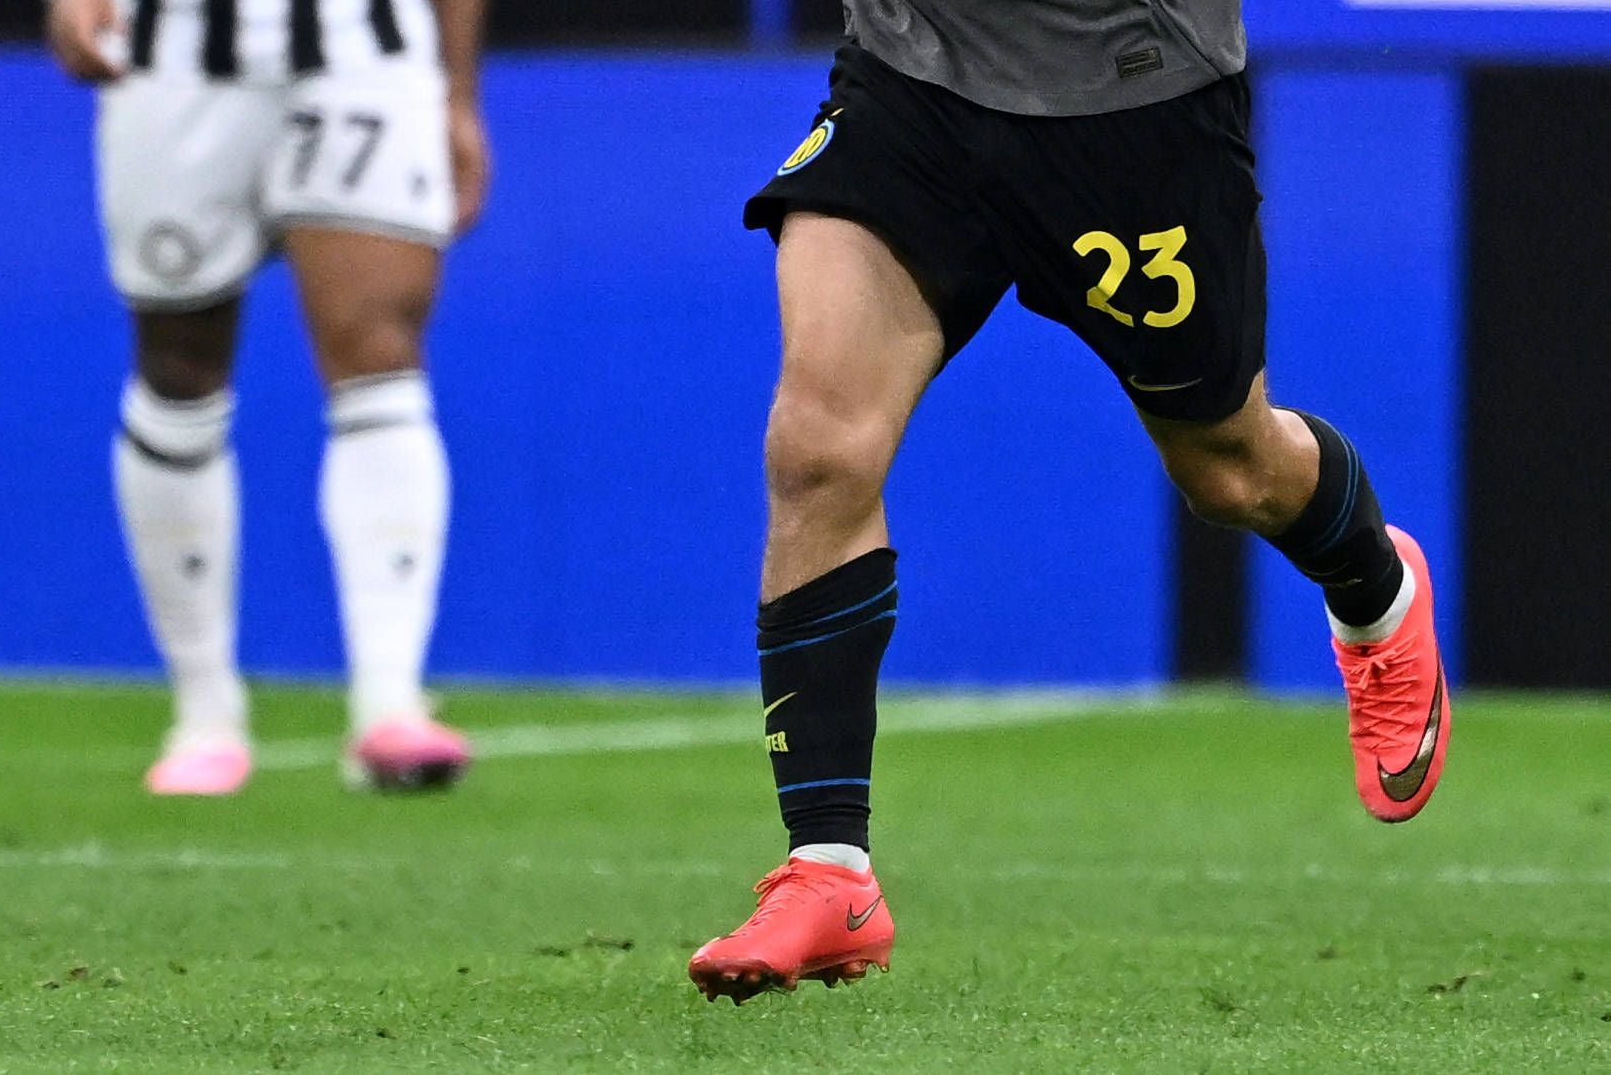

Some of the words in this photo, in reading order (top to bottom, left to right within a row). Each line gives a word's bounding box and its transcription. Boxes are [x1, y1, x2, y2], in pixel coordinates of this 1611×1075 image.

[285, 110, 386, 192] 77
[1072, 225, 1196, 328] 23
[764, 730, 789, 753] TER
